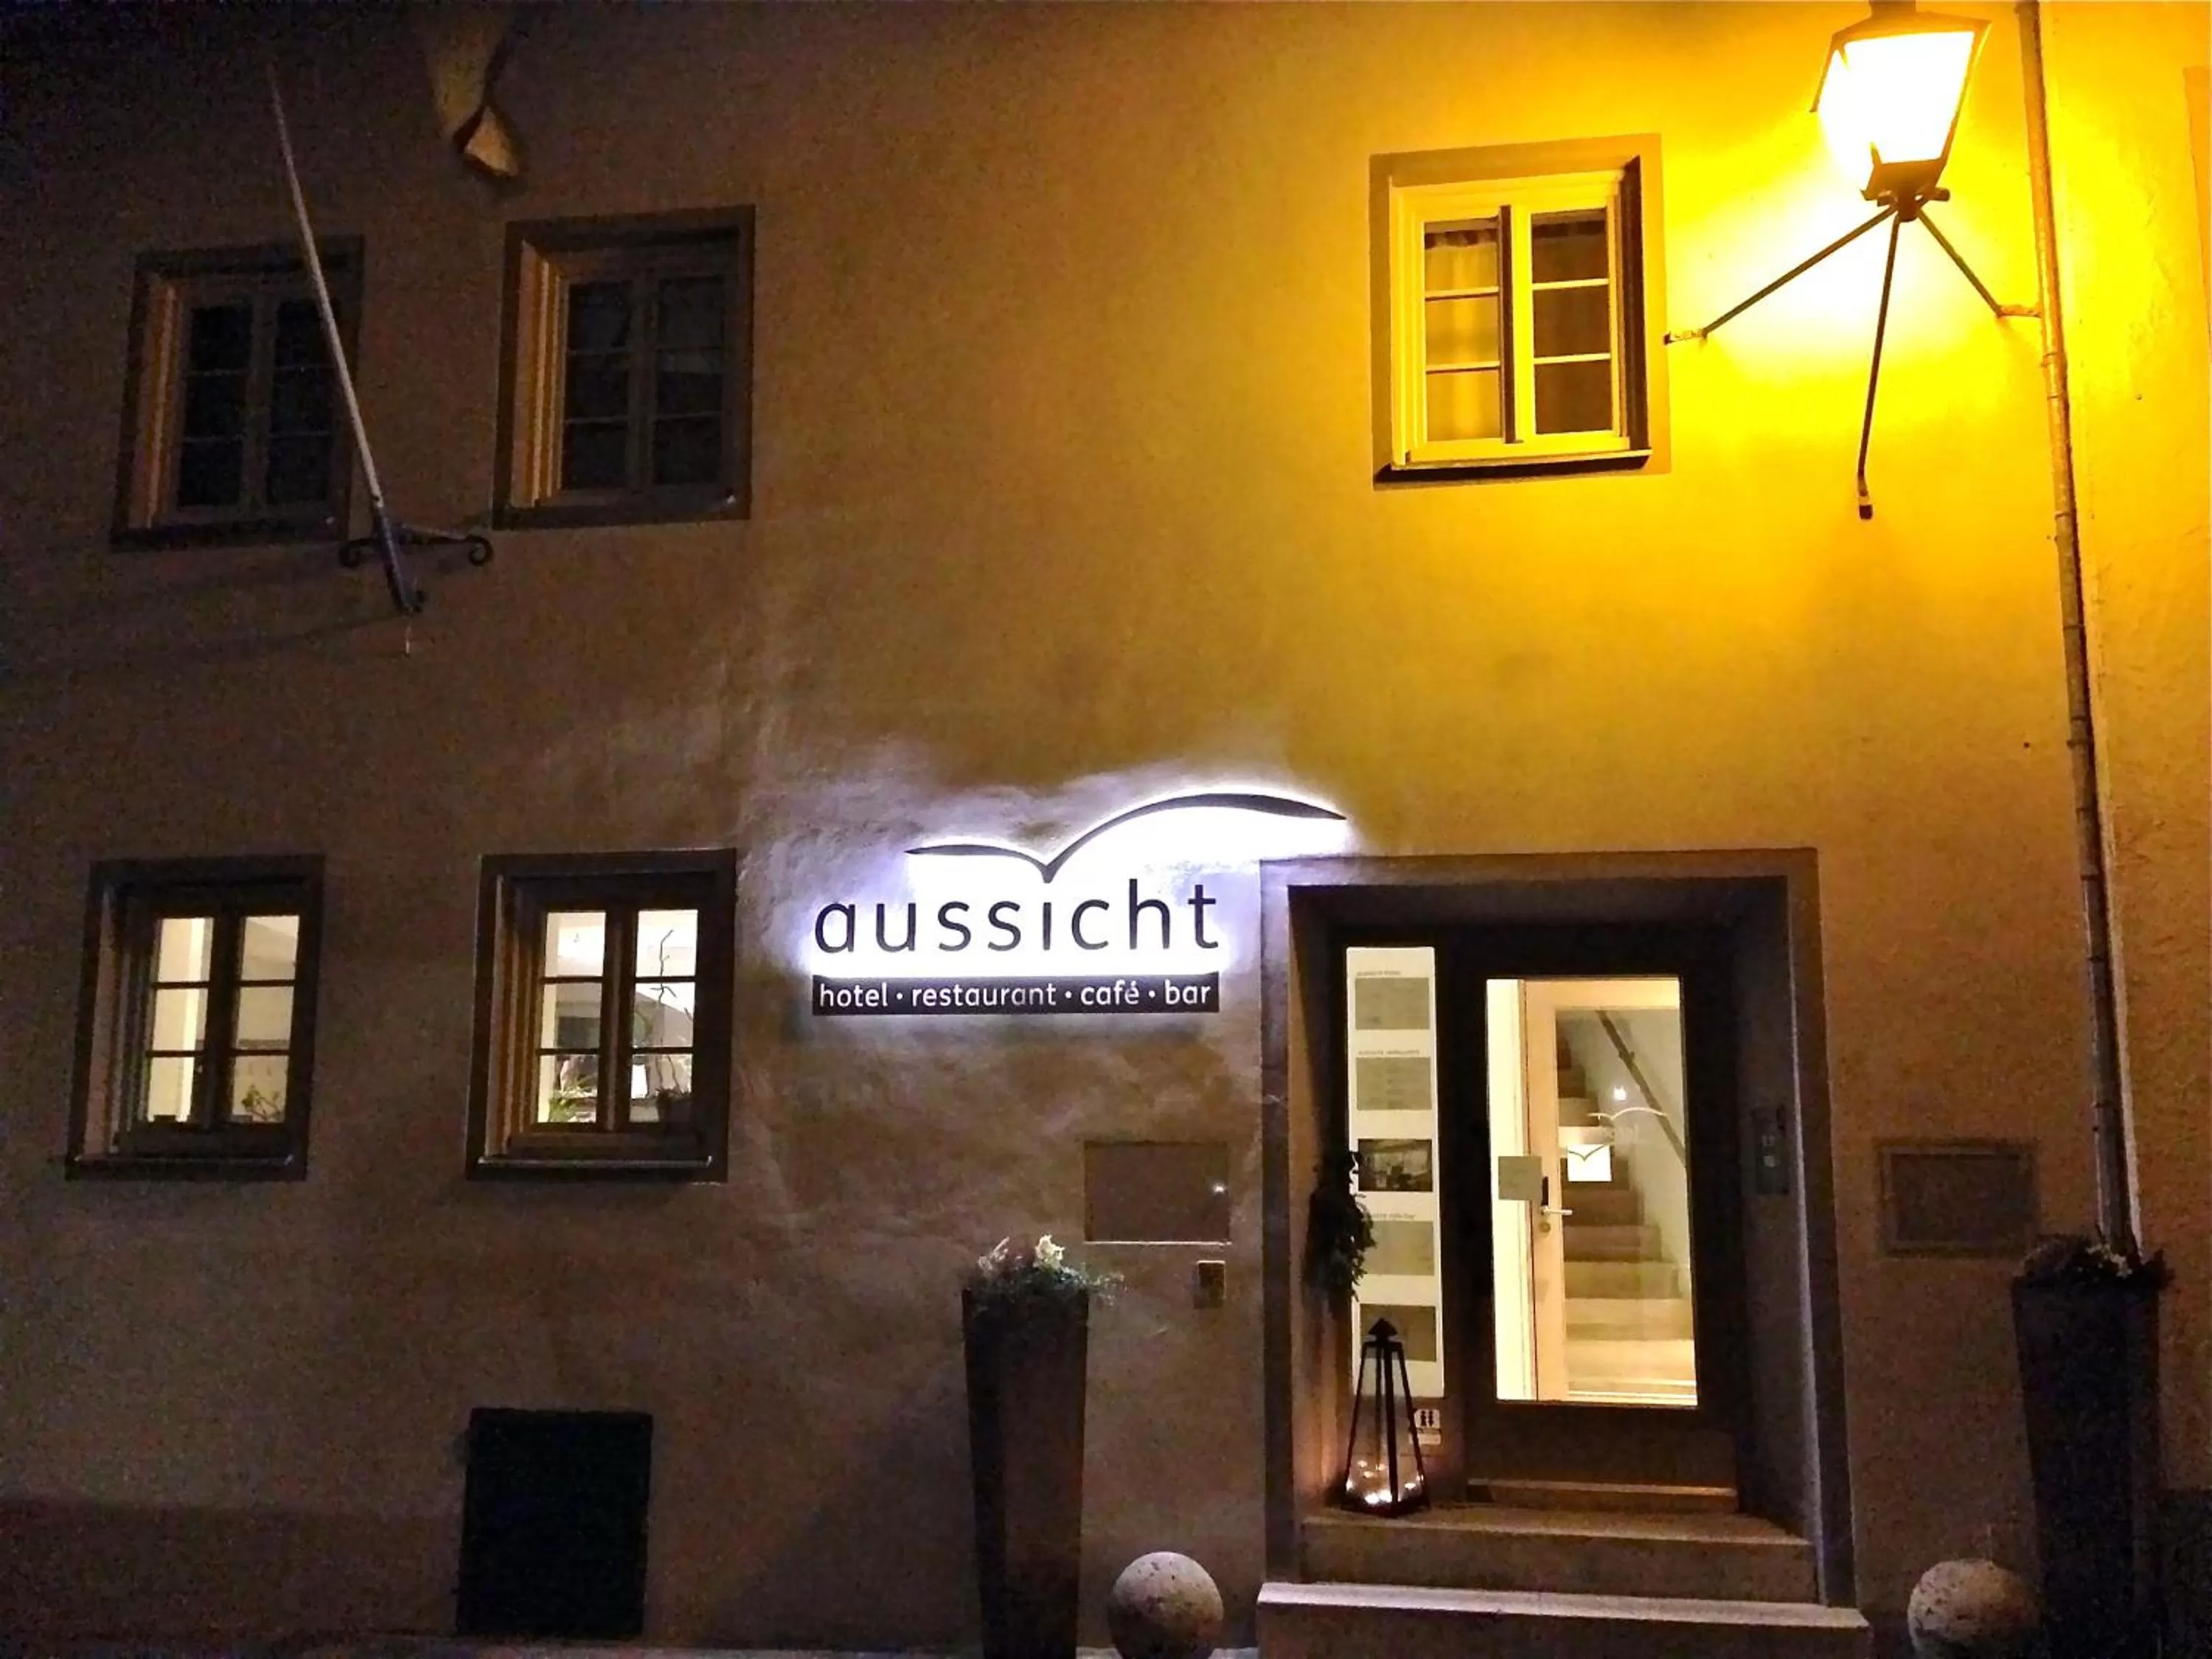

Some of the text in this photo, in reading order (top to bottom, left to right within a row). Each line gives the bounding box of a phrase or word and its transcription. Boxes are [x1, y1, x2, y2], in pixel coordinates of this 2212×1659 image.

[814, 878, 1219, 953] aussicht
[819, 979, 1211, 1007] hotel restaurant café bar
